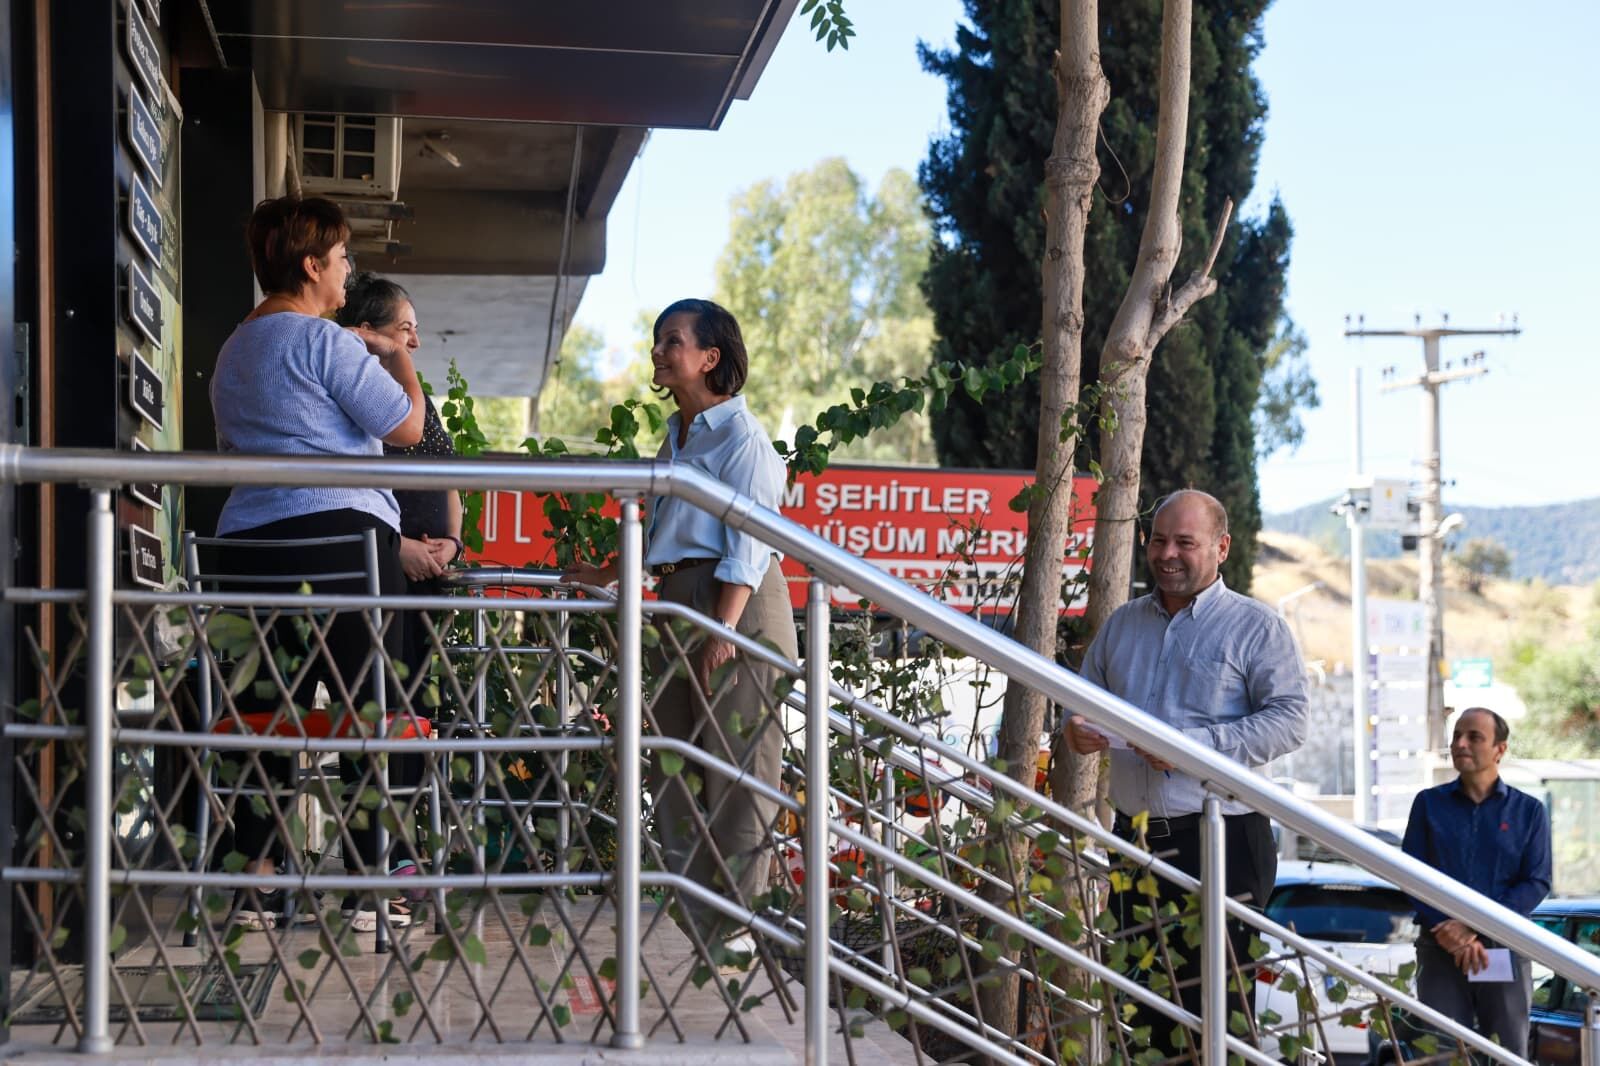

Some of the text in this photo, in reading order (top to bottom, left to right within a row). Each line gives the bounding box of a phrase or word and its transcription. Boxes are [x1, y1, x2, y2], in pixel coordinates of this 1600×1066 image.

[816, 480, 991, 514] ŞEHİTLER
[812, 519, 1094, 558] ÜŞÜM MERKZİ
